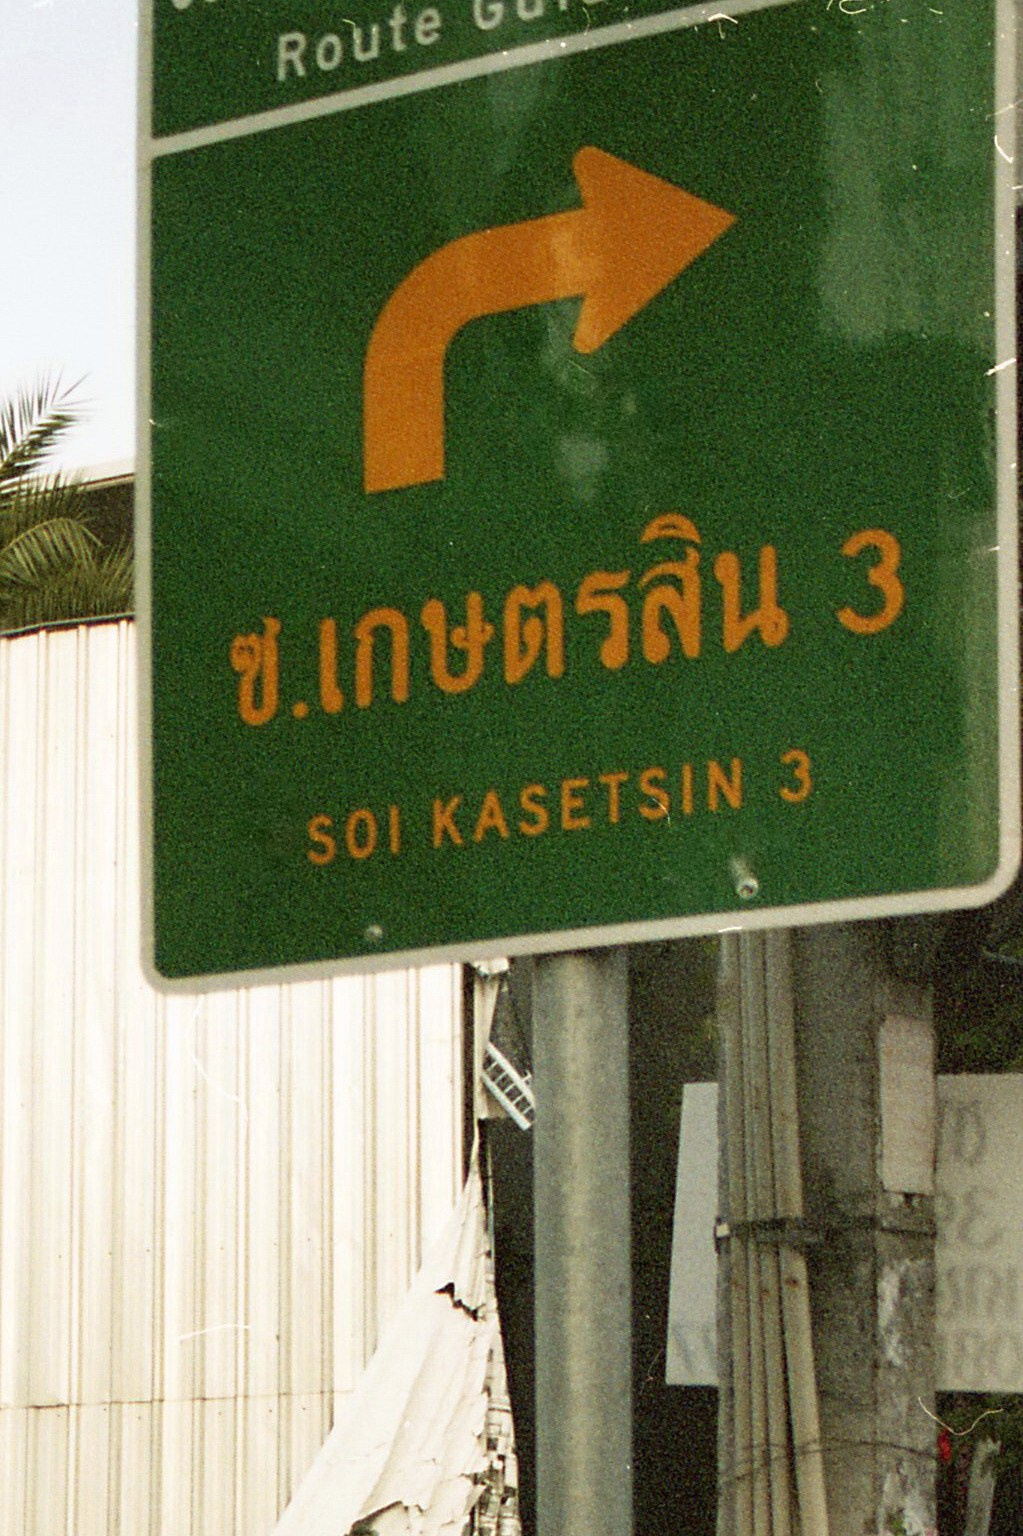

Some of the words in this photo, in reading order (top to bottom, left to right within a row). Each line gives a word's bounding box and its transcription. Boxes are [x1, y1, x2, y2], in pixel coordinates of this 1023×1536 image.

[276, 6, 442, 81] Route
[837, 528, 904, 634] 3
[306, 804, 400, 866] SOI
[432, 757, 743, 848] KASETSIN
[779, 748, 812, 803] 3
